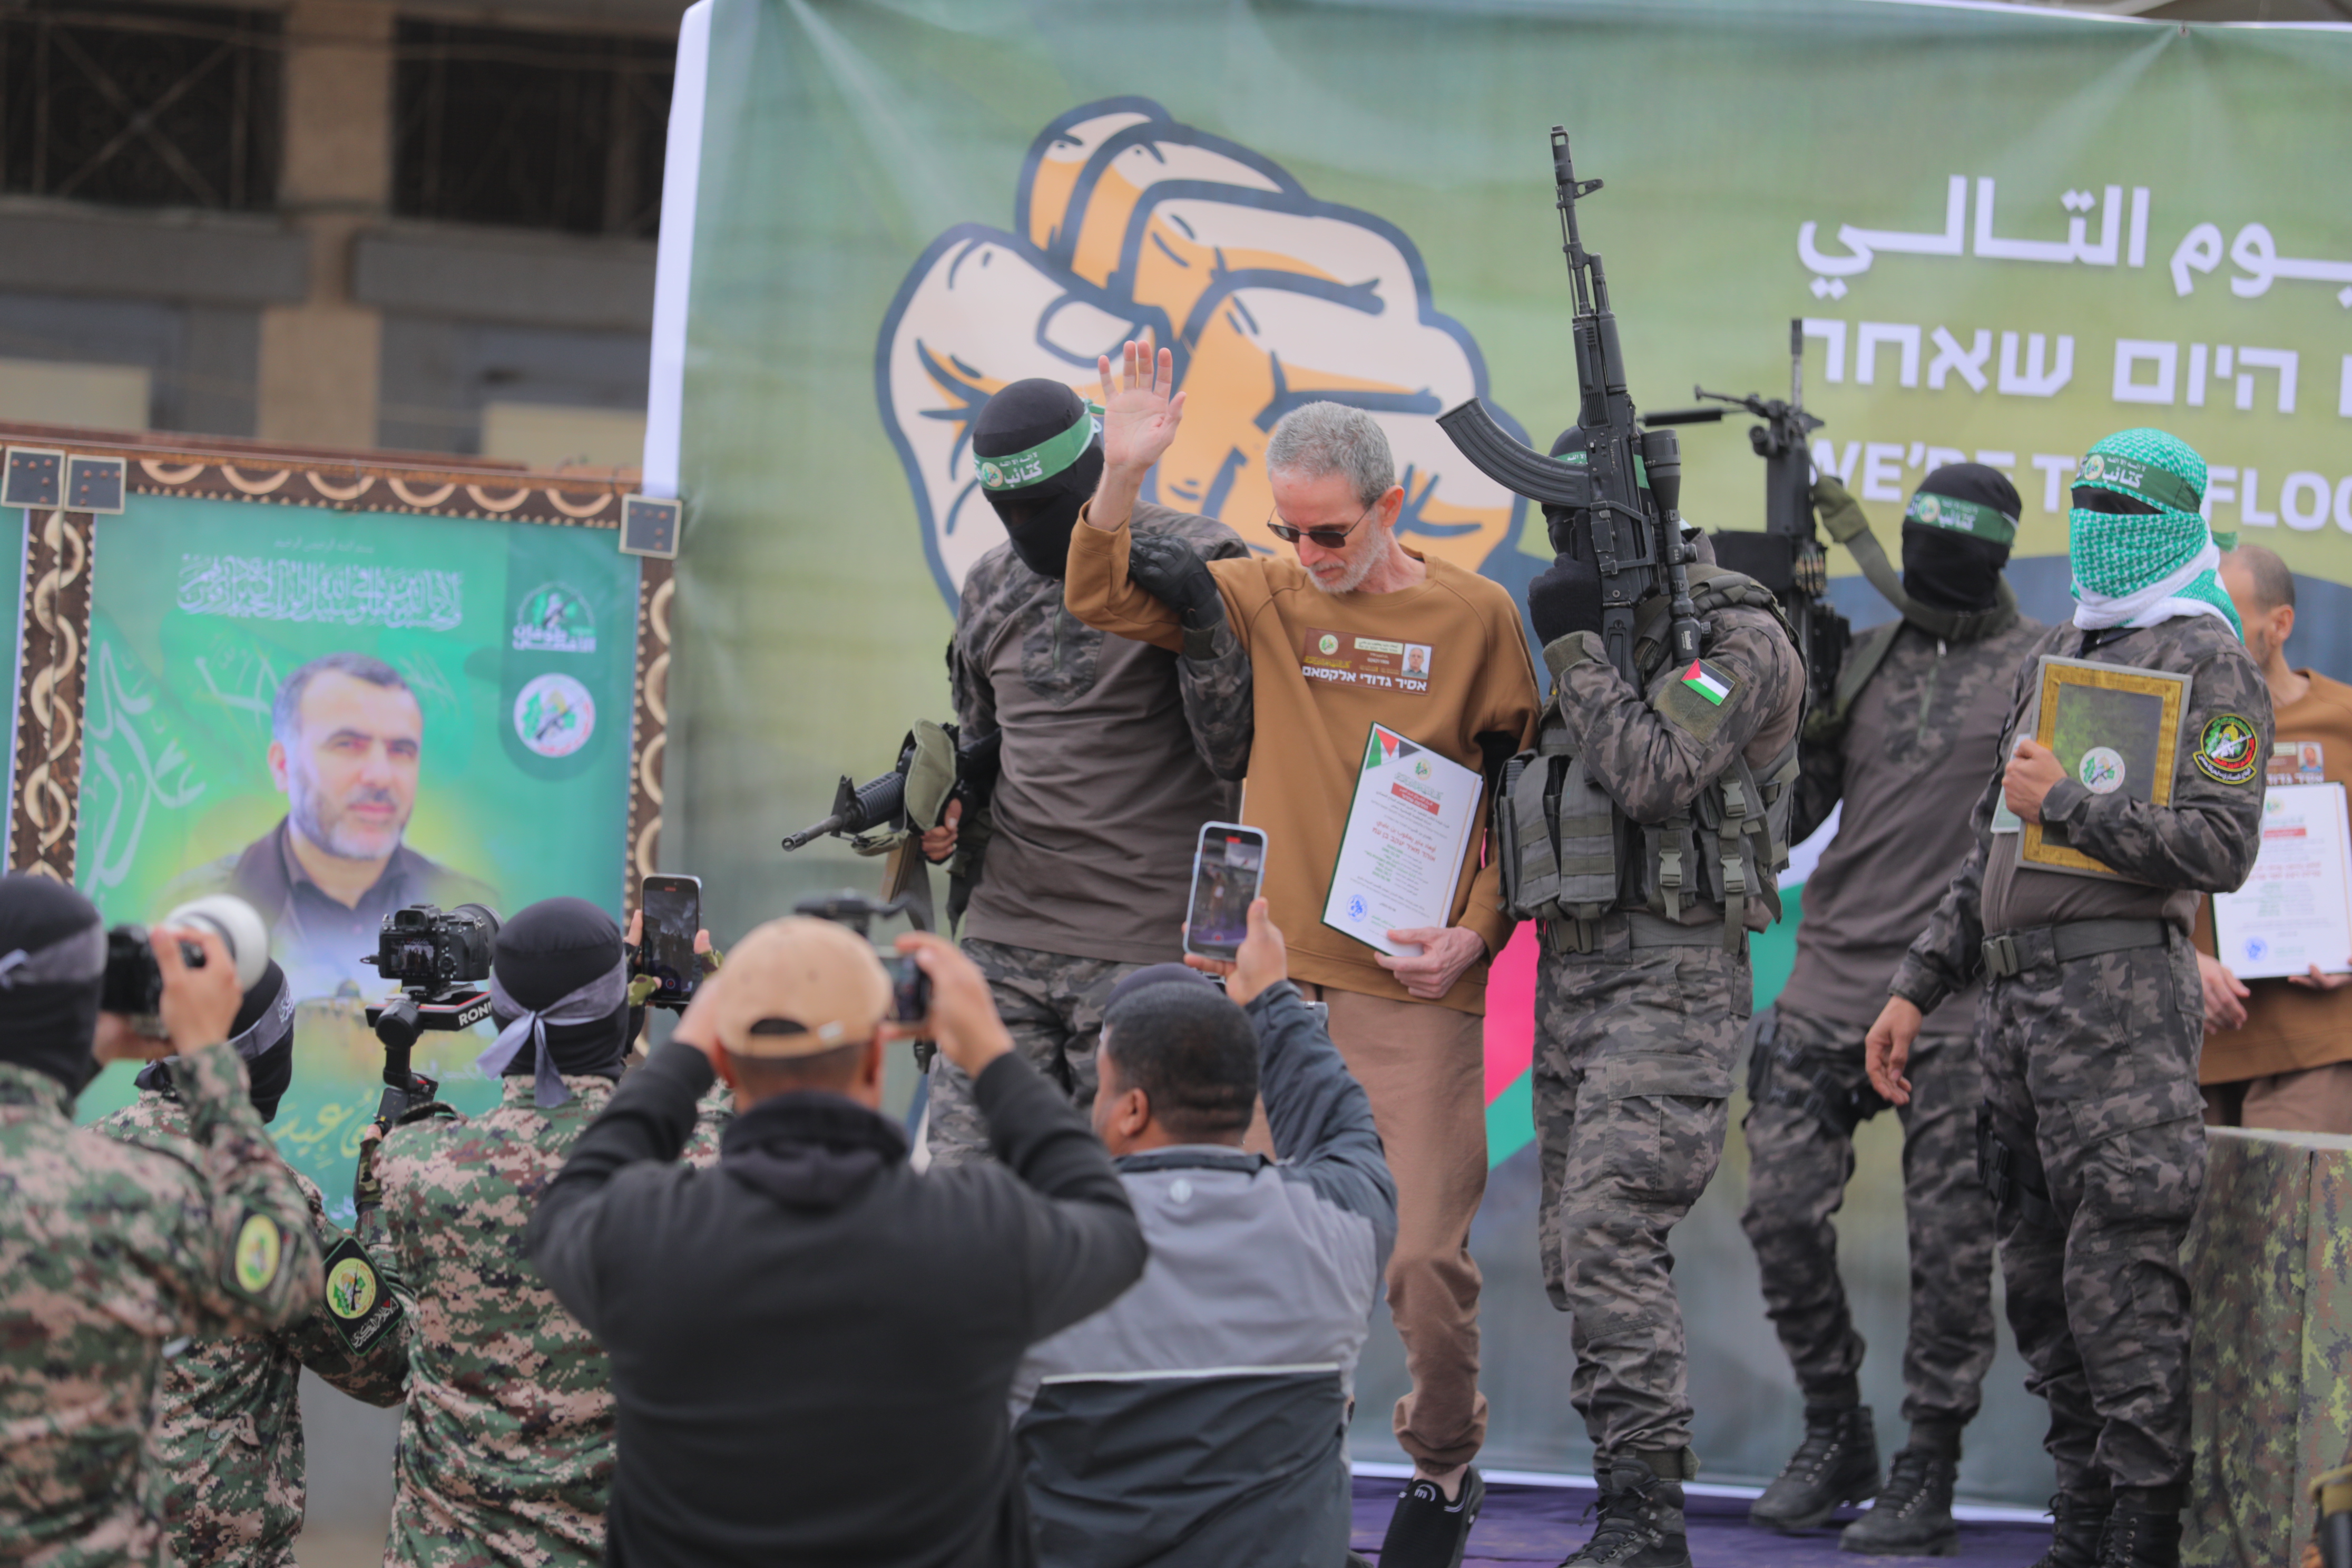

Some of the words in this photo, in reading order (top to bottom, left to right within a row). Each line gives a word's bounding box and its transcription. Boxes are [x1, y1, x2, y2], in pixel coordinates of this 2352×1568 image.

[1797, 174, 2150, 300] التالي
[2170, 222, 2352, 310] وم
[1802, 318, 2075, 398] שאחר
[2112, 338, 2299, 414] היום
[2102, 466, 2143, 489] كتائب
[1302, 665, 1356, 682] אלקסאם
[1360, 673, 1392, 687] גדודי
[1395, 677, 1427, 691] אסיר
[458, 1001, 492, 1027] RONI
